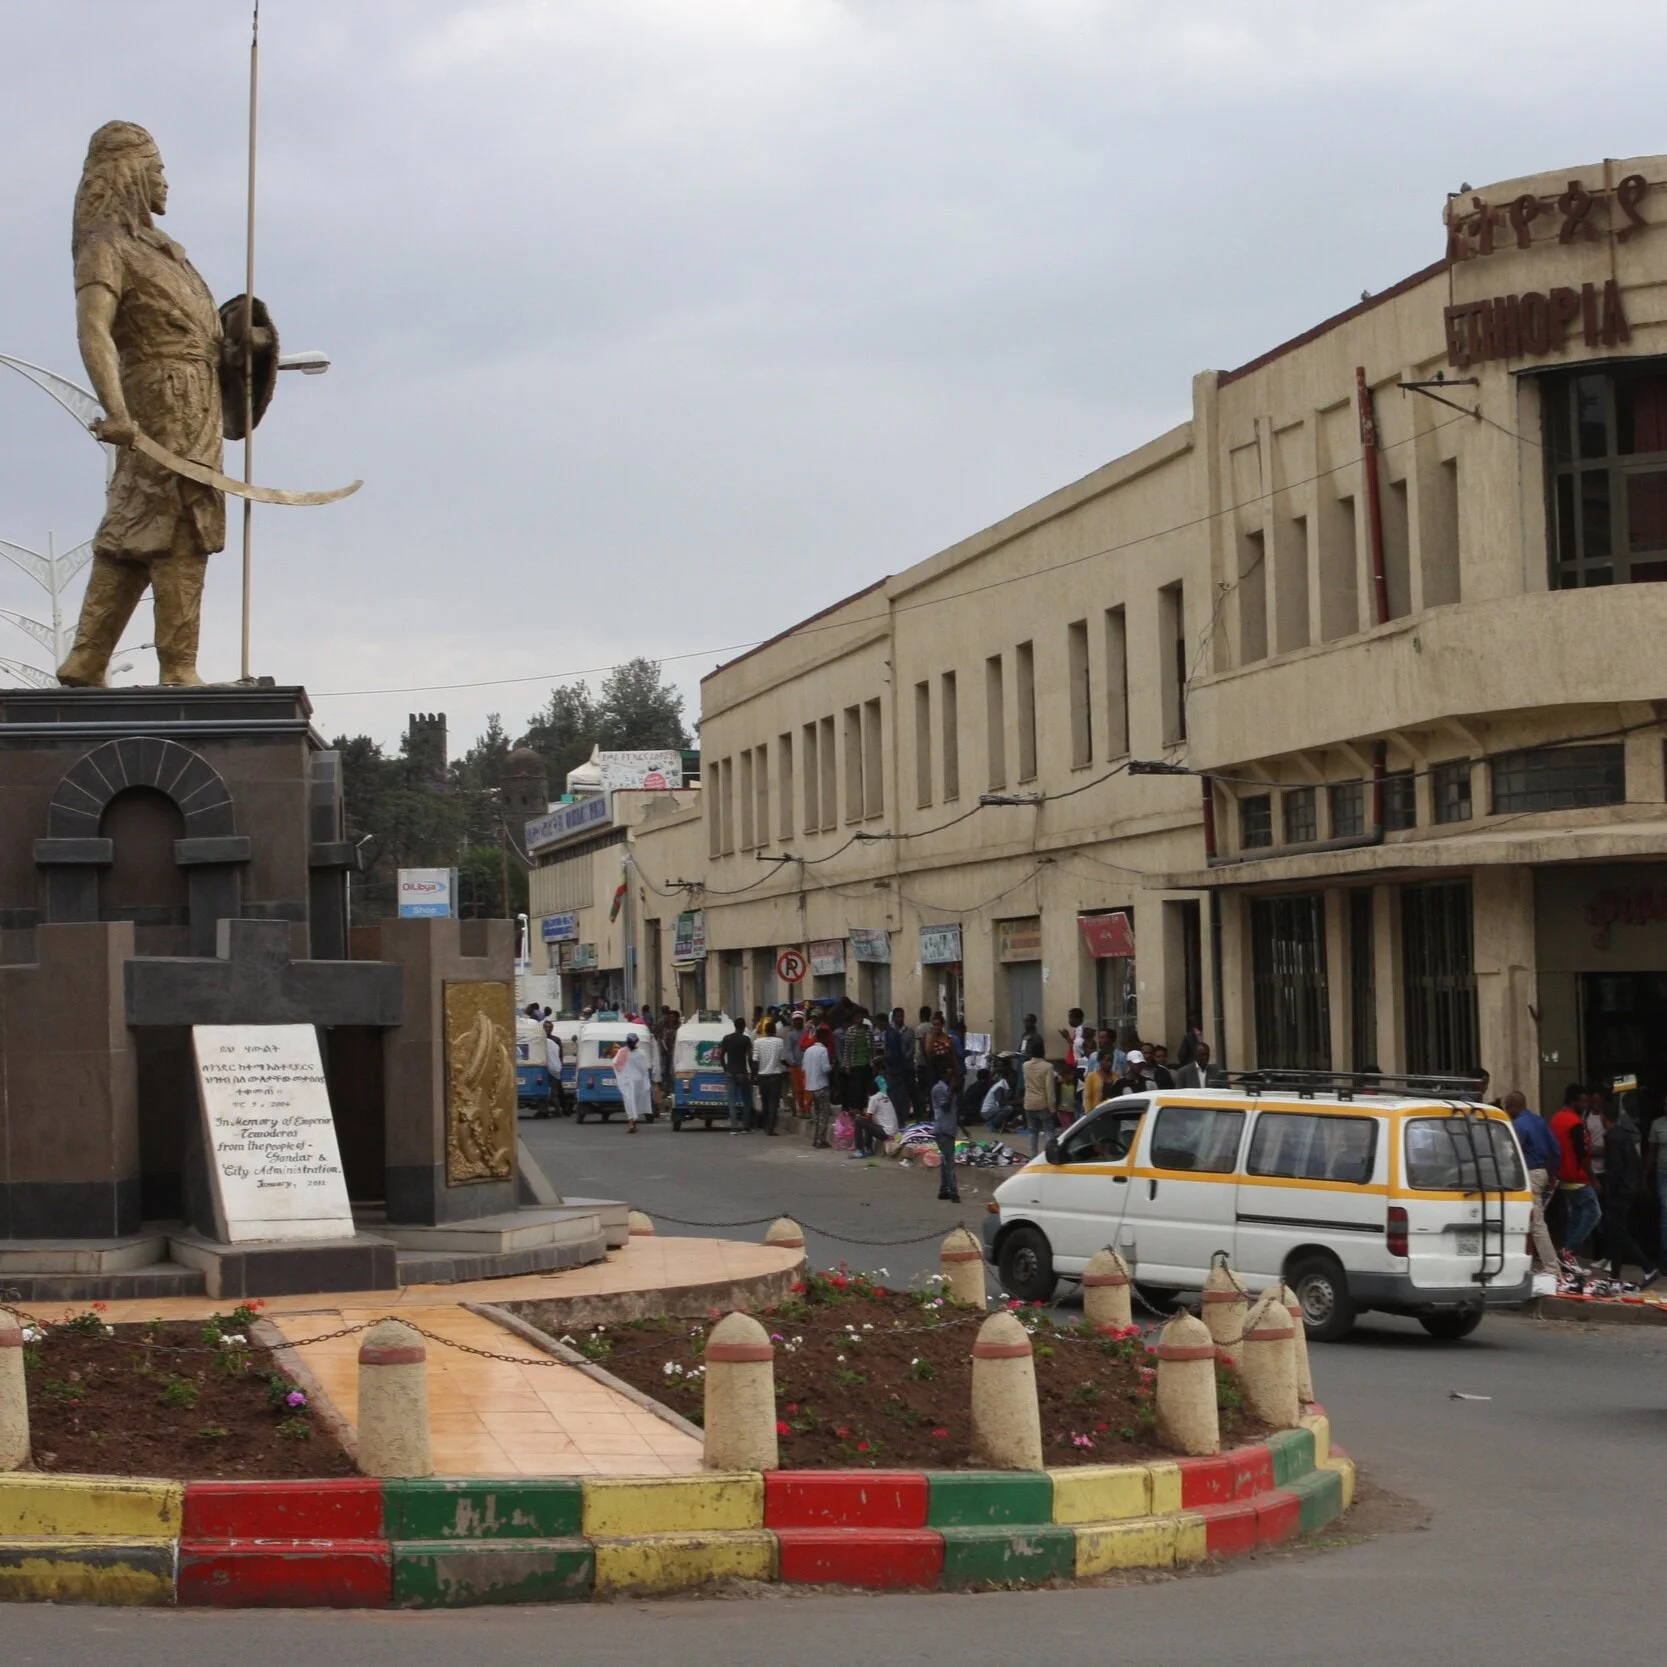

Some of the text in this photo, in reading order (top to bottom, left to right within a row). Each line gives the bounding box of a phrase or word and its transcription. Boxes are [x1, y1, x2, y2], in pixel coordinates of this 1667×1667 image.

[1444, 279, 1631, 367] ETHIOPIA
[215, 1116, 230, 1127] In
[231, 1117, 278, 1129] Memory
[281, 1116, 294, 1127] of
[217, 1141, 245, 1152] from
[247, 1140, 264, 1151] the
[265, 1142, 294, 1153] people
[295, 1140, 306, 1151] of
[318, 1153, 327, 1162] &
[222, 1163, 251, 1180] City
